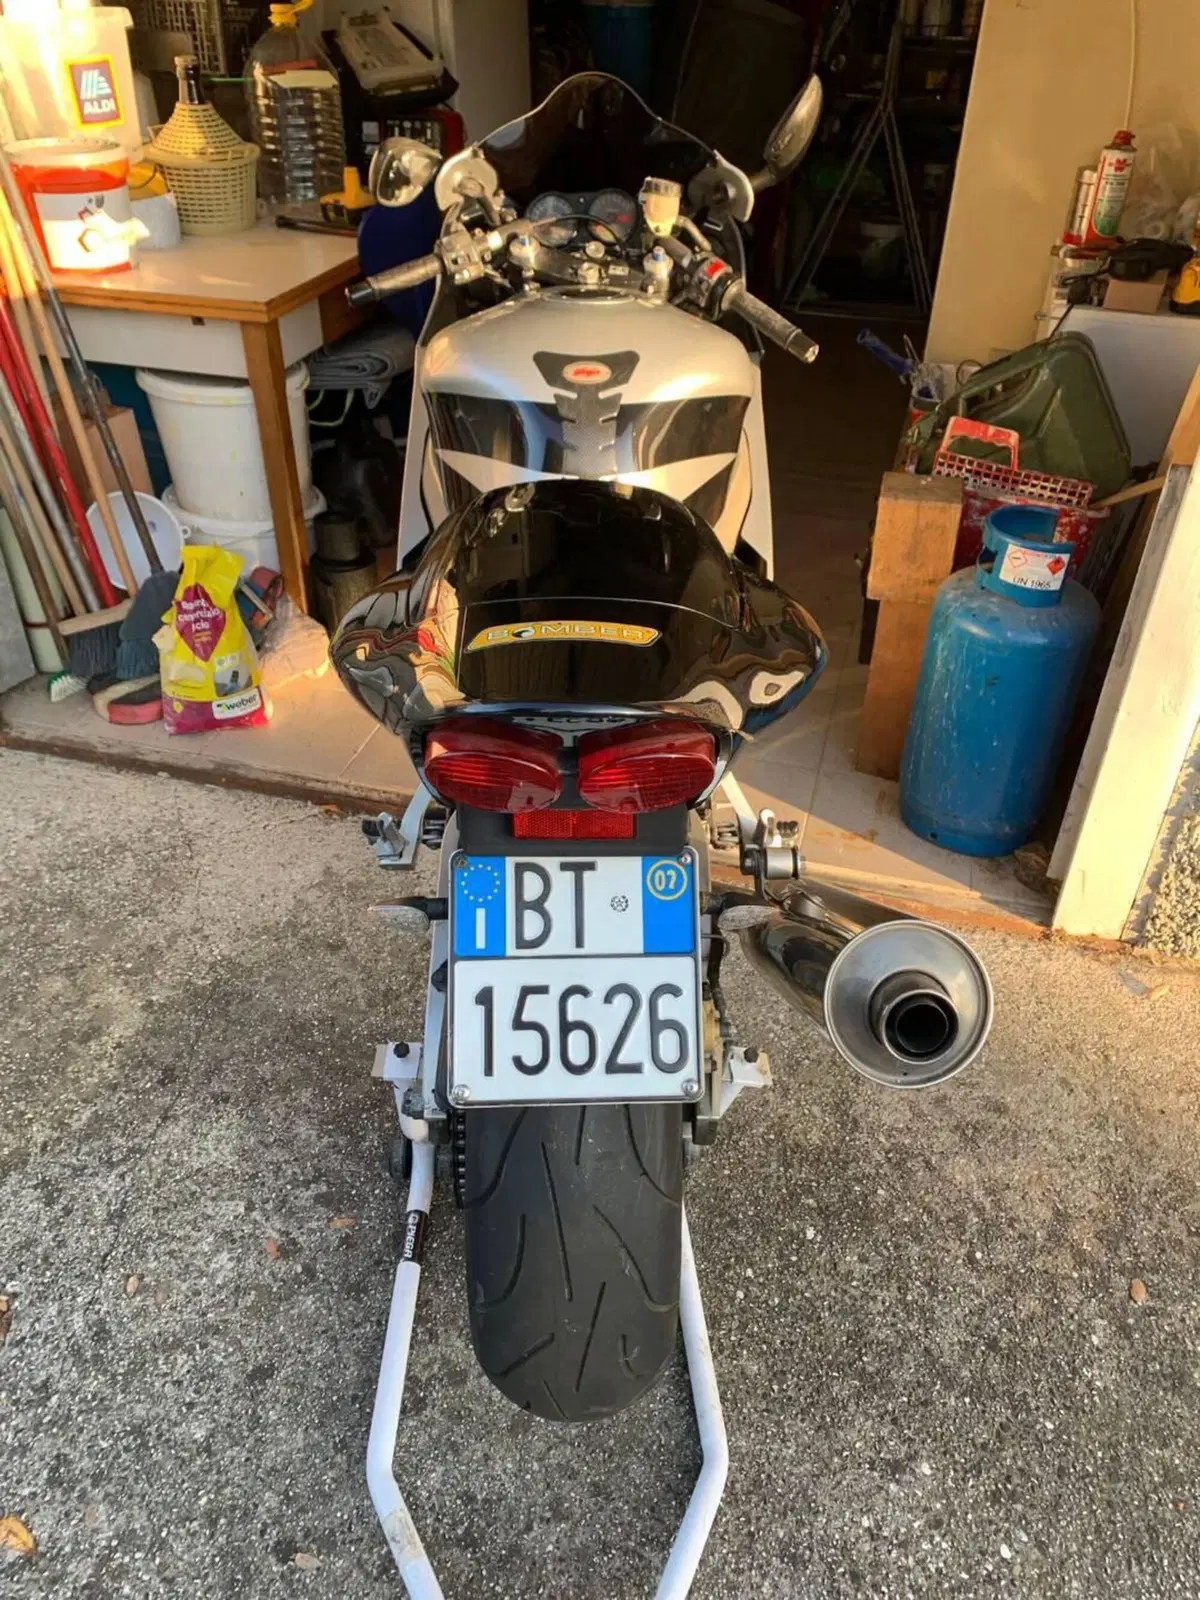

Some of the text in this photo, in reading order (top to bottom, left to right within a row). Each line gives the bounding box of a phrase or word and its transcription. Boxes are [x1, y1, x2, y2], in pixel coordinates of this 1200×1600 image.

[83, 98, 117, 115] ALDI
[1012, 576, 1051, 589] UN 1965
[226, 694, 258, 711] weber
[654, 869, 678, 892] 07
[514, 861, 598, 950] BT
[474, 983, 690, 1076] 15626
